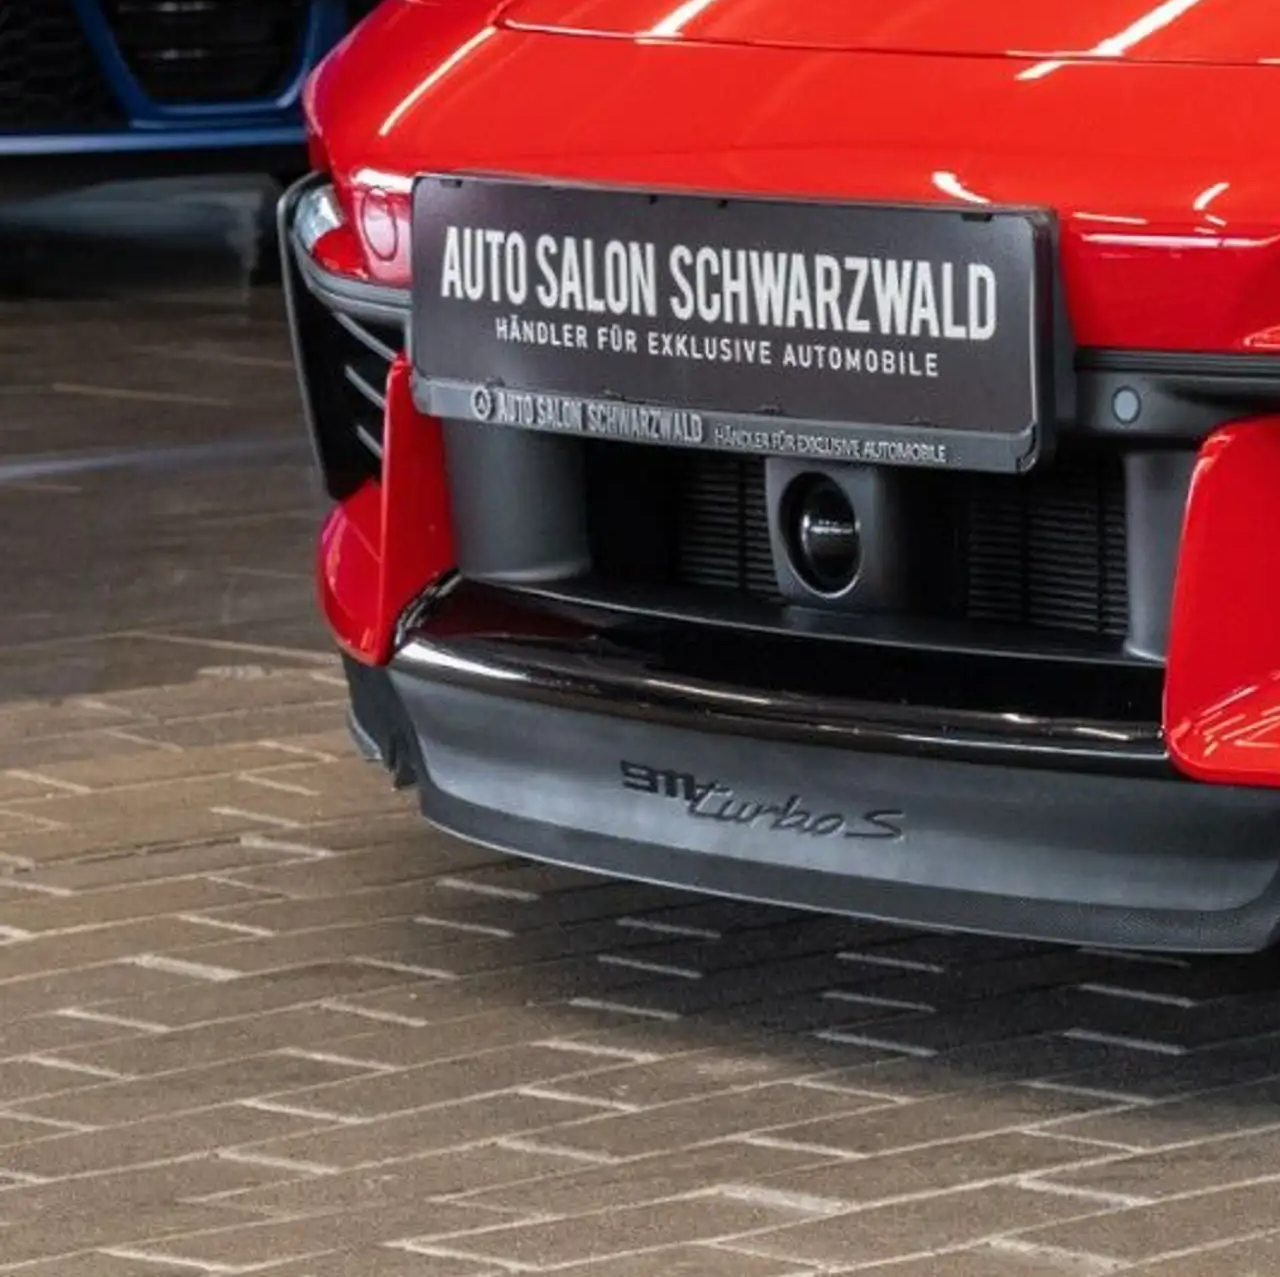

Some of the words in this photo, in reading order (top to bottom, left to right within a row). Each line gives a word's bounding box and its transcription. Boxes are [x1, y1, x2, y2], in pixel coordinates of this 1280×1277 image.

[441, 226, 527, 305] AUTO
[535, 234, 657, 317] SALON
[669, 244, 997, 341] SCHWARZWALD
[495, 314, 588, 349] HÄNDLER
[598, 325, 638, 353] FÜR
[648, 331, 773, 365] EXKLUSIVE
[783, 343, 939, 378] AUTOMOBILE
[499, 391, 536, 426] AUTO
[536, 393, 585, 431] SALON
[588, 403, 704, 443] SCHWARZWALD
